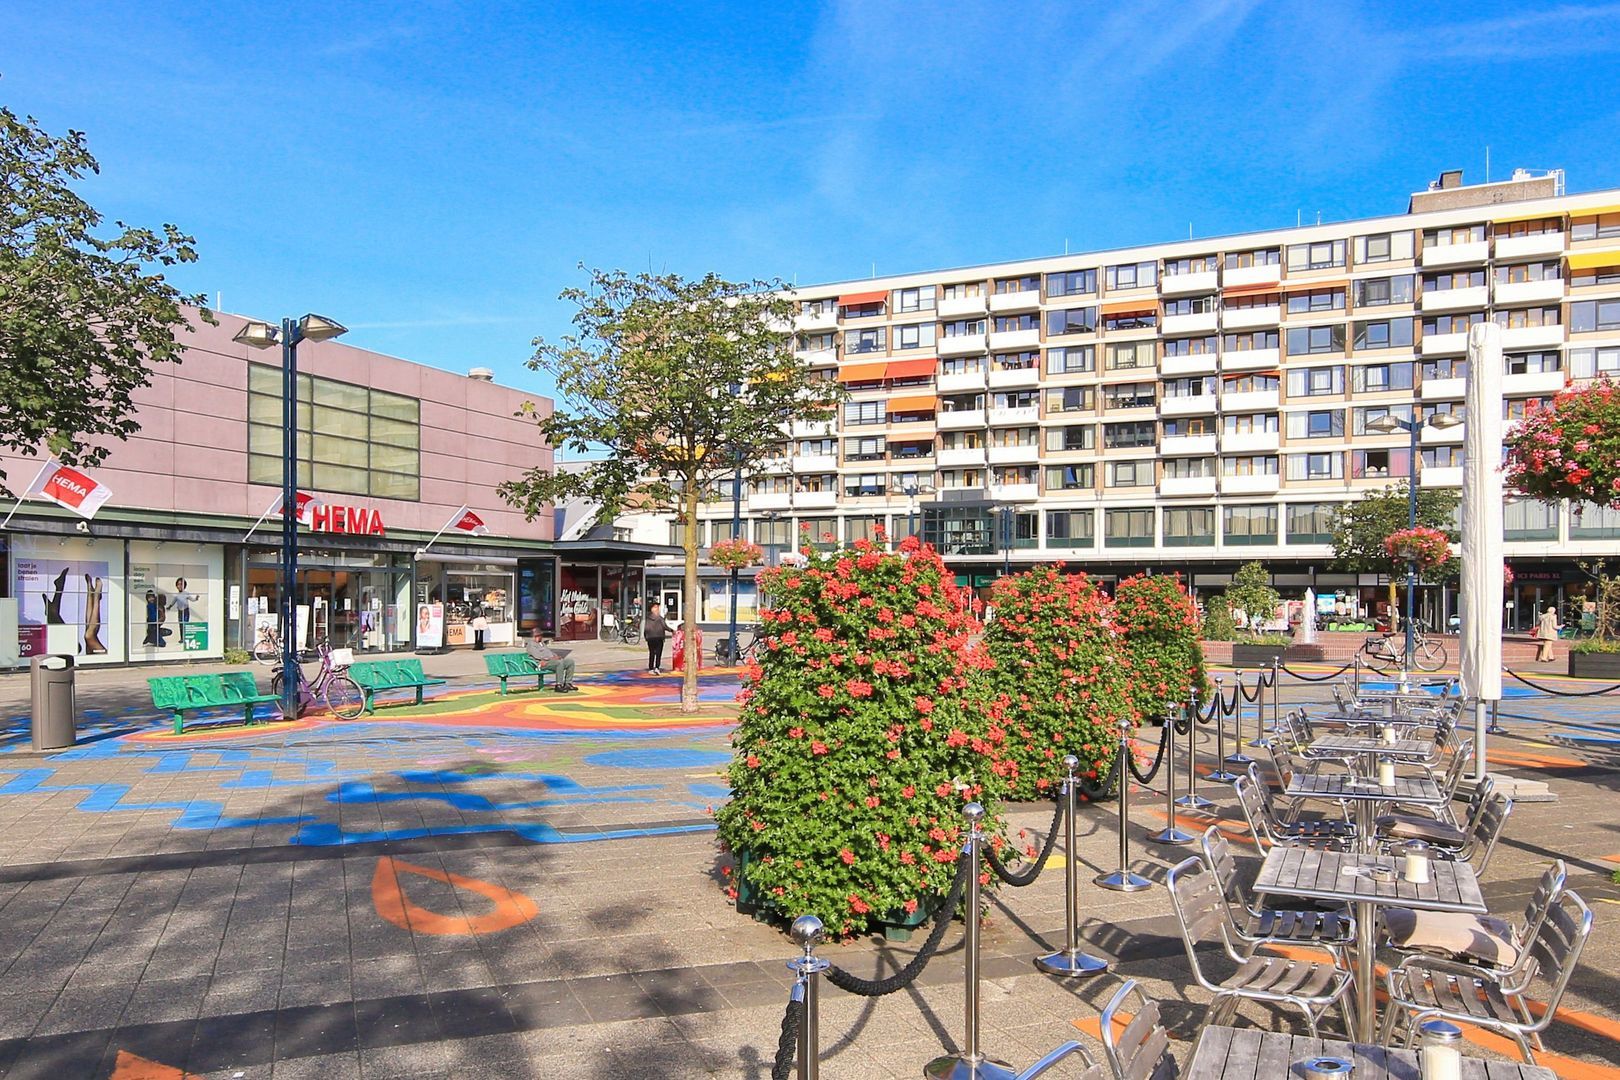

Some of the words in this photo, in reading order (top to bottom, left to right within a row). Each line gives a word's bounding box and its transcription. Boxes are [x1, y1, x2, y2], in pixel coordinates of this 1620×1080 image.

[52, 474, 87, 497] HEMA
[309, 504, 385, 536] HEMA
[446, 628, 463, 637] EMA
